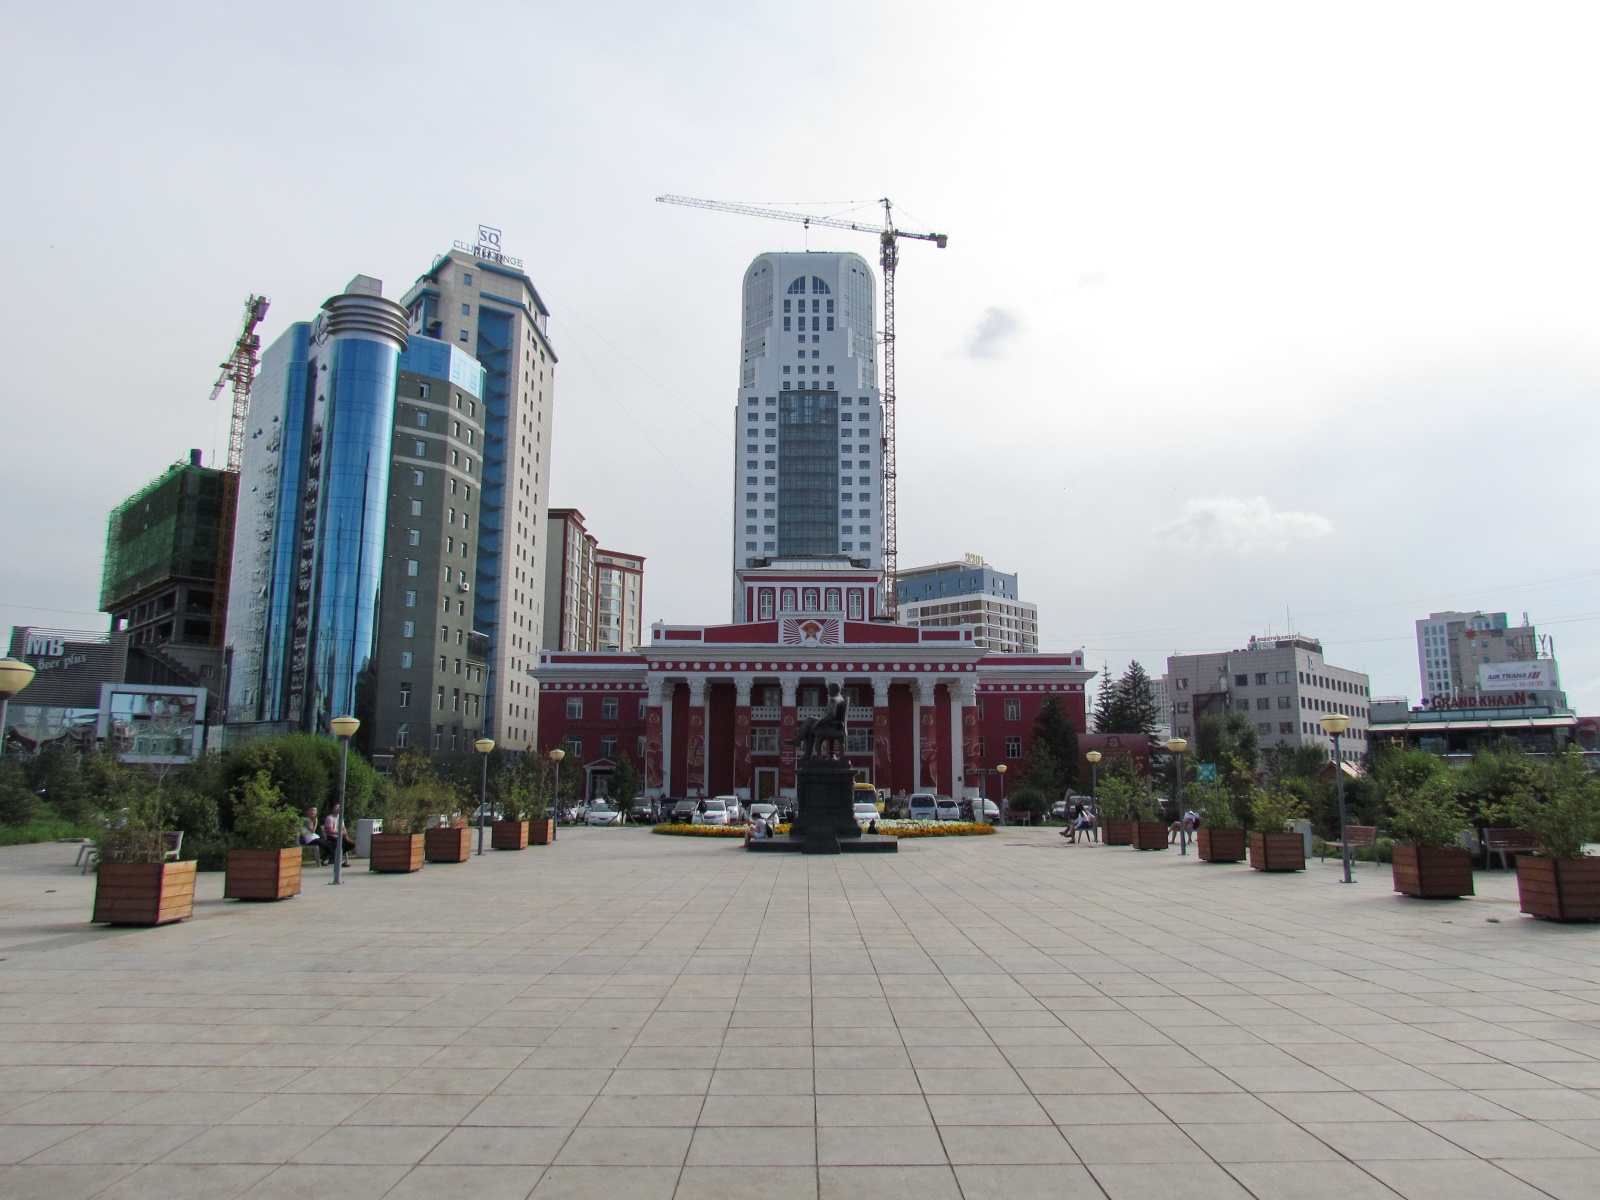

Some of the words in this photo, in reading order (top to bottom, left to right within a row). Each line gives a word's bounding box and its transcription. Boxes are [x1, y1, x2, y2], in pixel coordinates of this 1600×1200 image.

[26, 635, 65, 656] MB
[1431, 695, 1477, 709] GRAND
[1478, 691, 1526, 707] KHAAN
